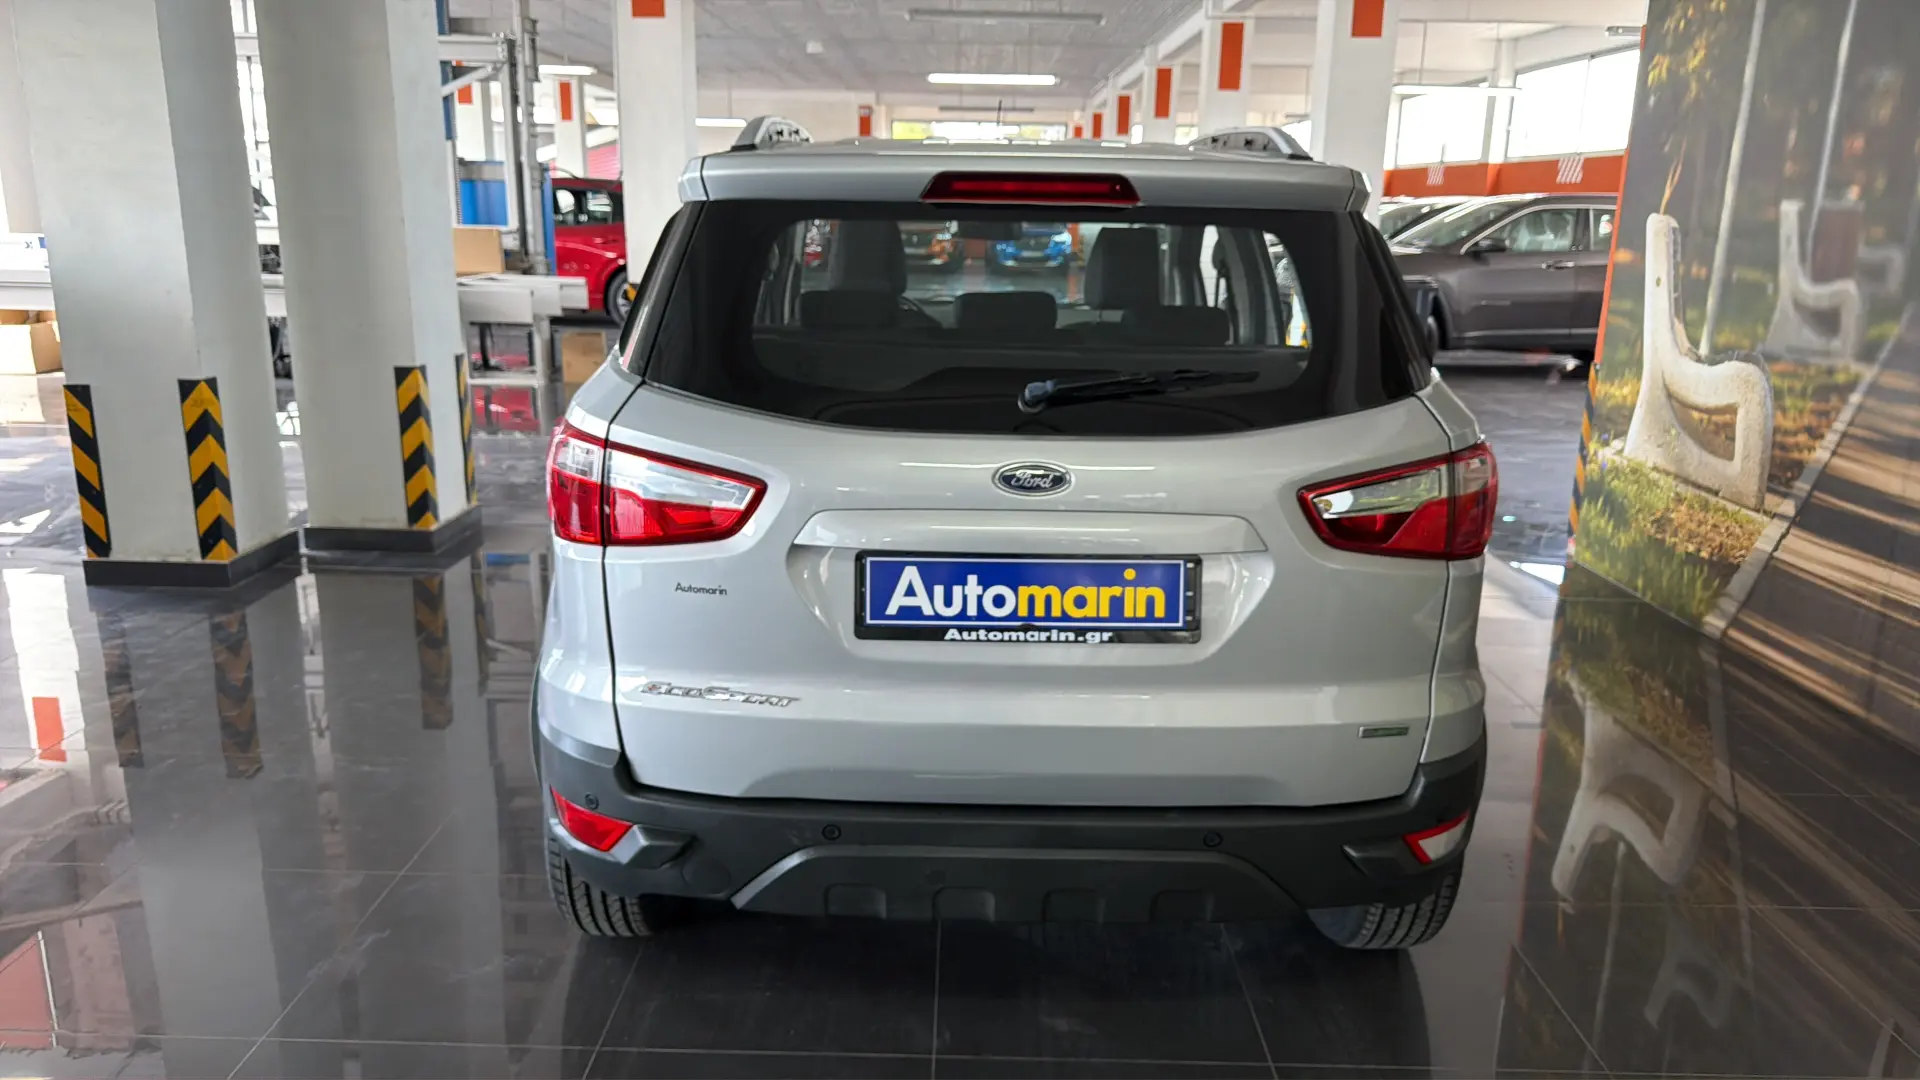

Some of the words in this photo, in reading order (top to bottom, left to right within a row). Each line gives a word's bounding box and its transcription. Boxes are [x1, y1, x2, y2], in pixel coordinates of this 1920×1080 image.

[1010, 470, 1054, 488] Ford
[674, 581, 728, 596] Automarin
[884, 565, 1165, 618] Automarin
[944, 627, 1113, 643] Automarin.gr
